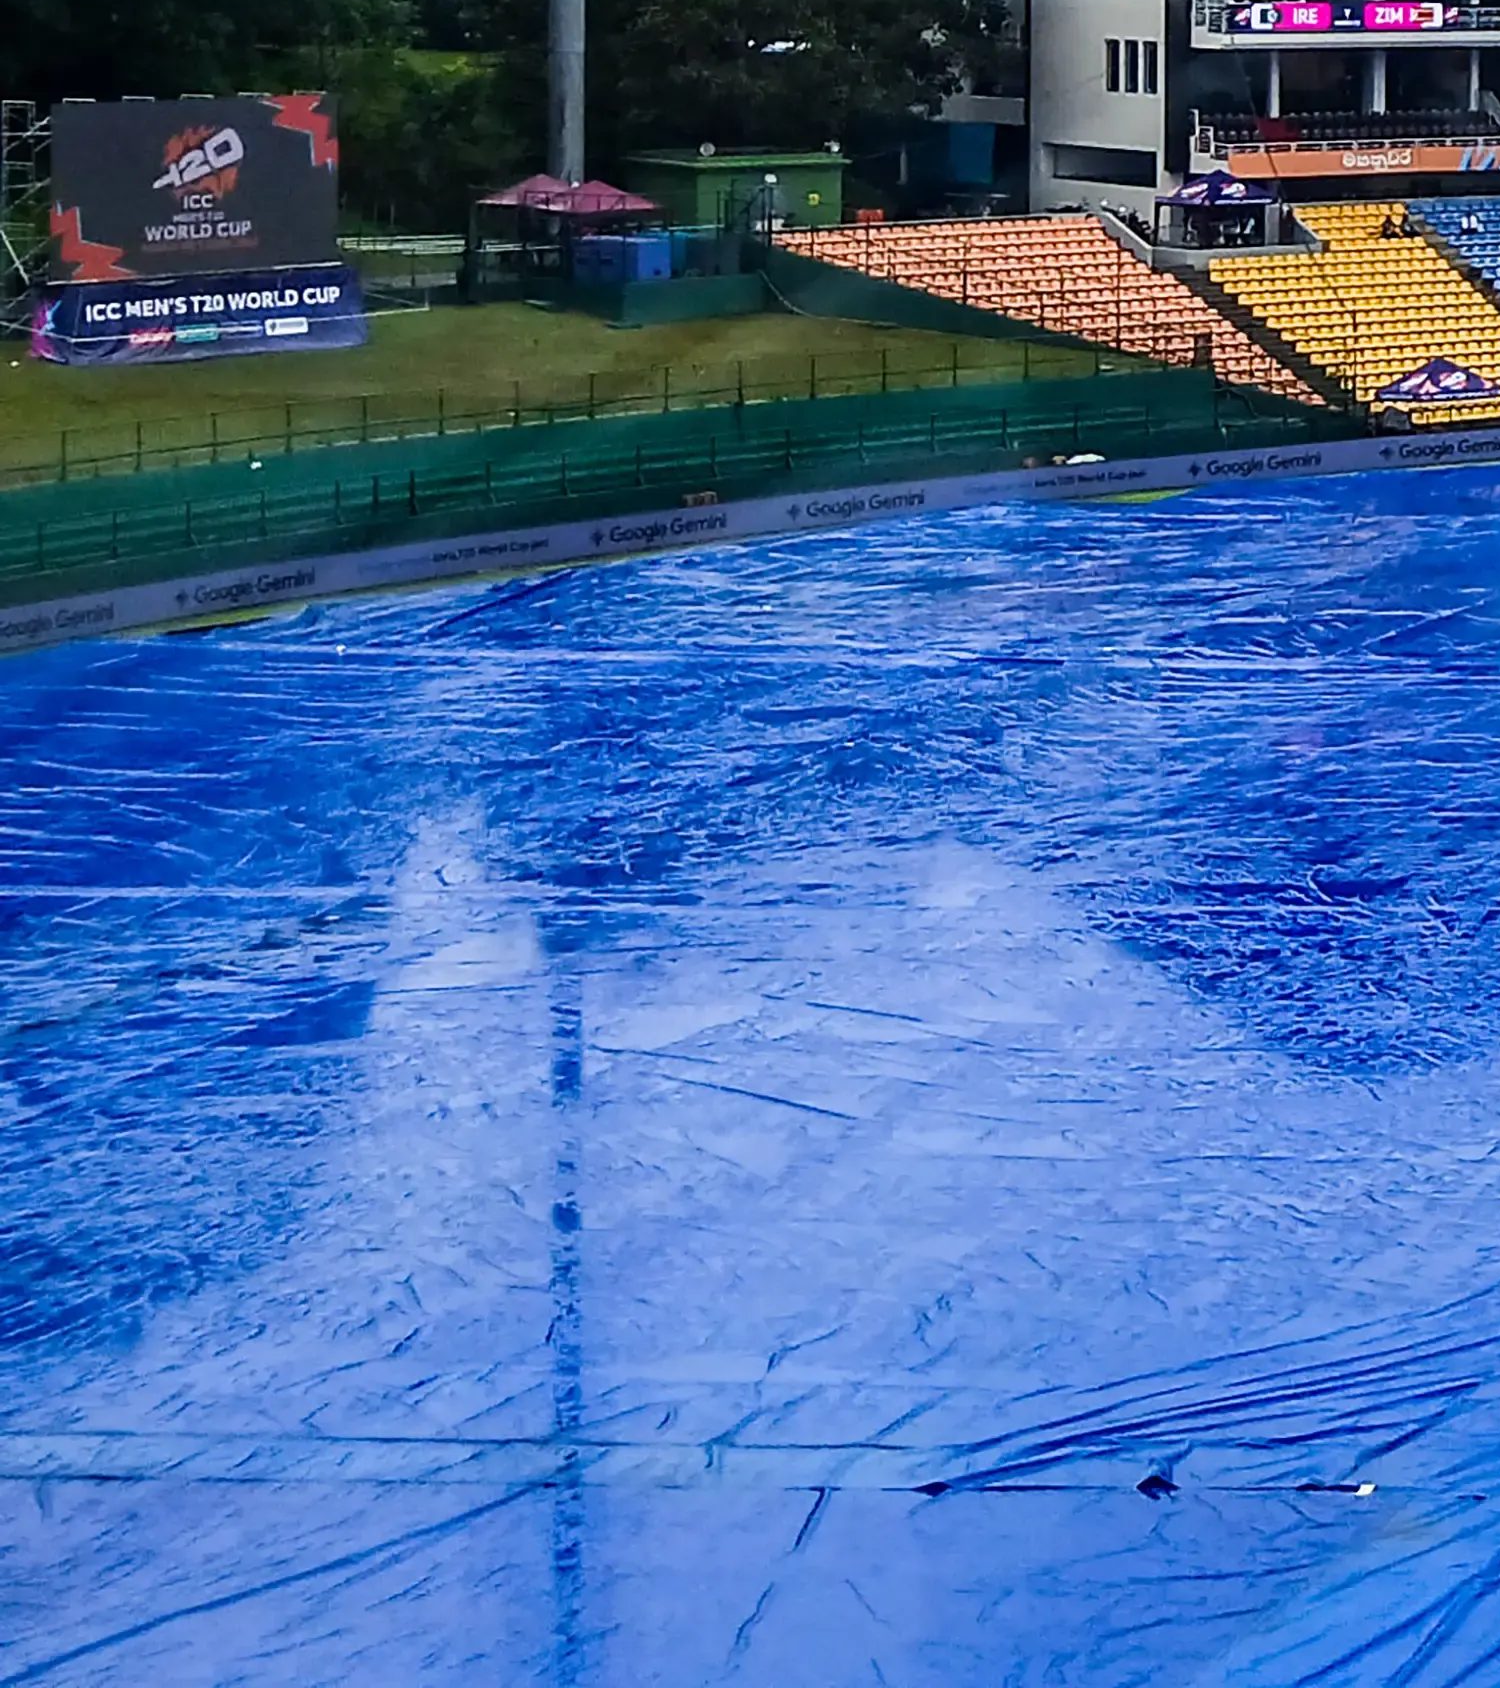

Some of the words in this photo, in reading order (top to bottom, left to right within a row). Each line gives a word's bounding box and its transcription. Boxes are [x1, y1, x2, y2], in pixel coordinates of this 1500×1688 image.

[1293, 7, 1318, 24] IRE
[1375, 7, 1403, 24] ZIM
[183, 194, 213, 209] ICC
[145, 223, 212, 242] WORLD
[217, 220, 252, 238] CUP
[86, 302, 121, 322] ICC
[125, 296, 187, 319] MEN'S
[190, 293, 224, 314] T20
[227, 288, 297, 310] WORLD
[302, 285, 341, 304] CUP
